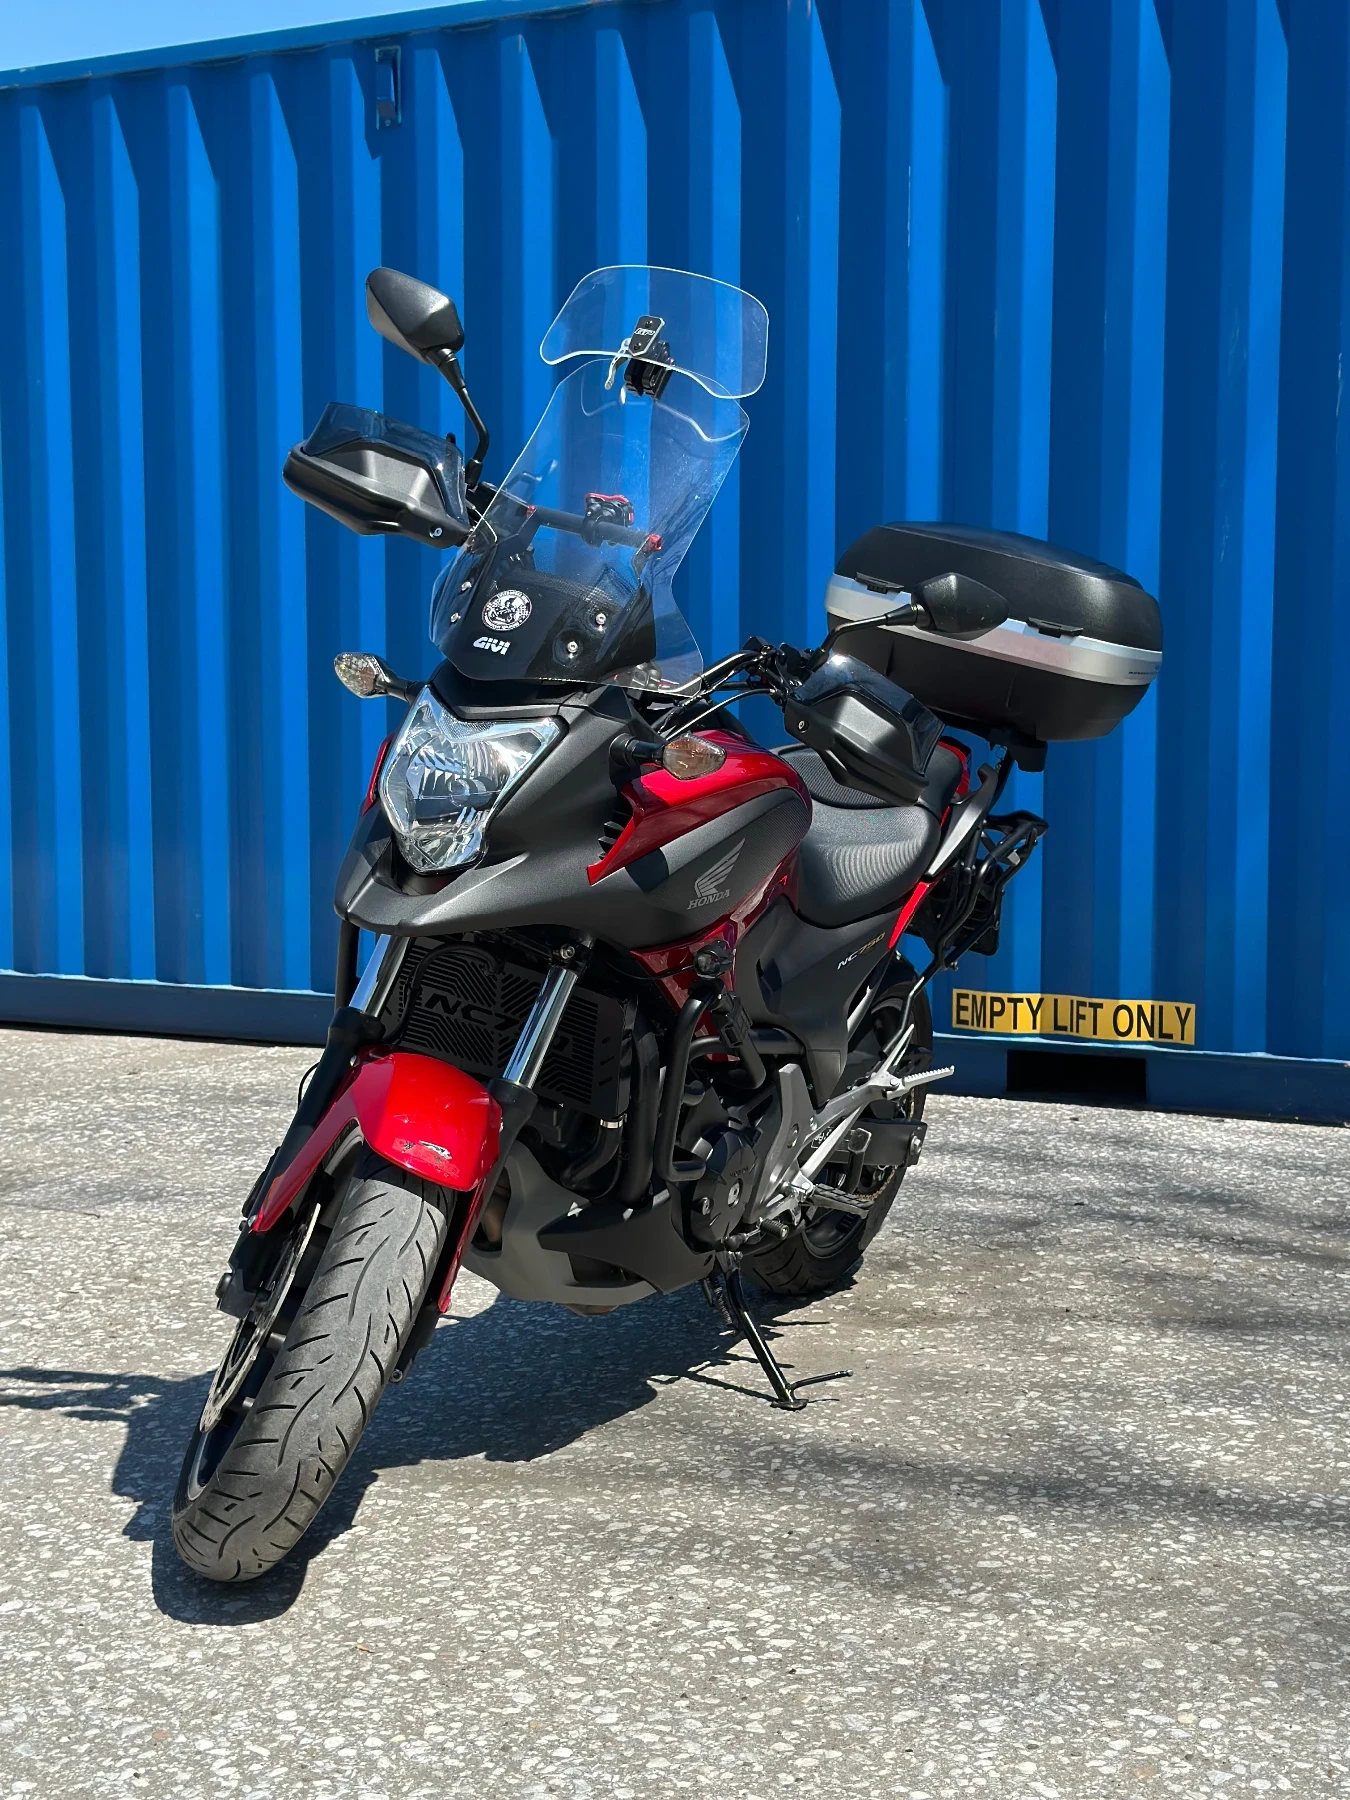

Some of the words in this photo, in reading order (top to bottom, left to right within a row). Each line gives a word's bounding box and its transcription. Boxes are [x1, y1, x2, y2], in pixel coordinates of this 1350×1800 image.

[473, 636, 511, 655] GIVI
[687, 889, 731, 910] HONDA
[956, 992, 1045, 1030] EMPTY
[1053, 998, 1104, 1036] LIFT
[1112, 1003, 1192, 1041] ONLY
